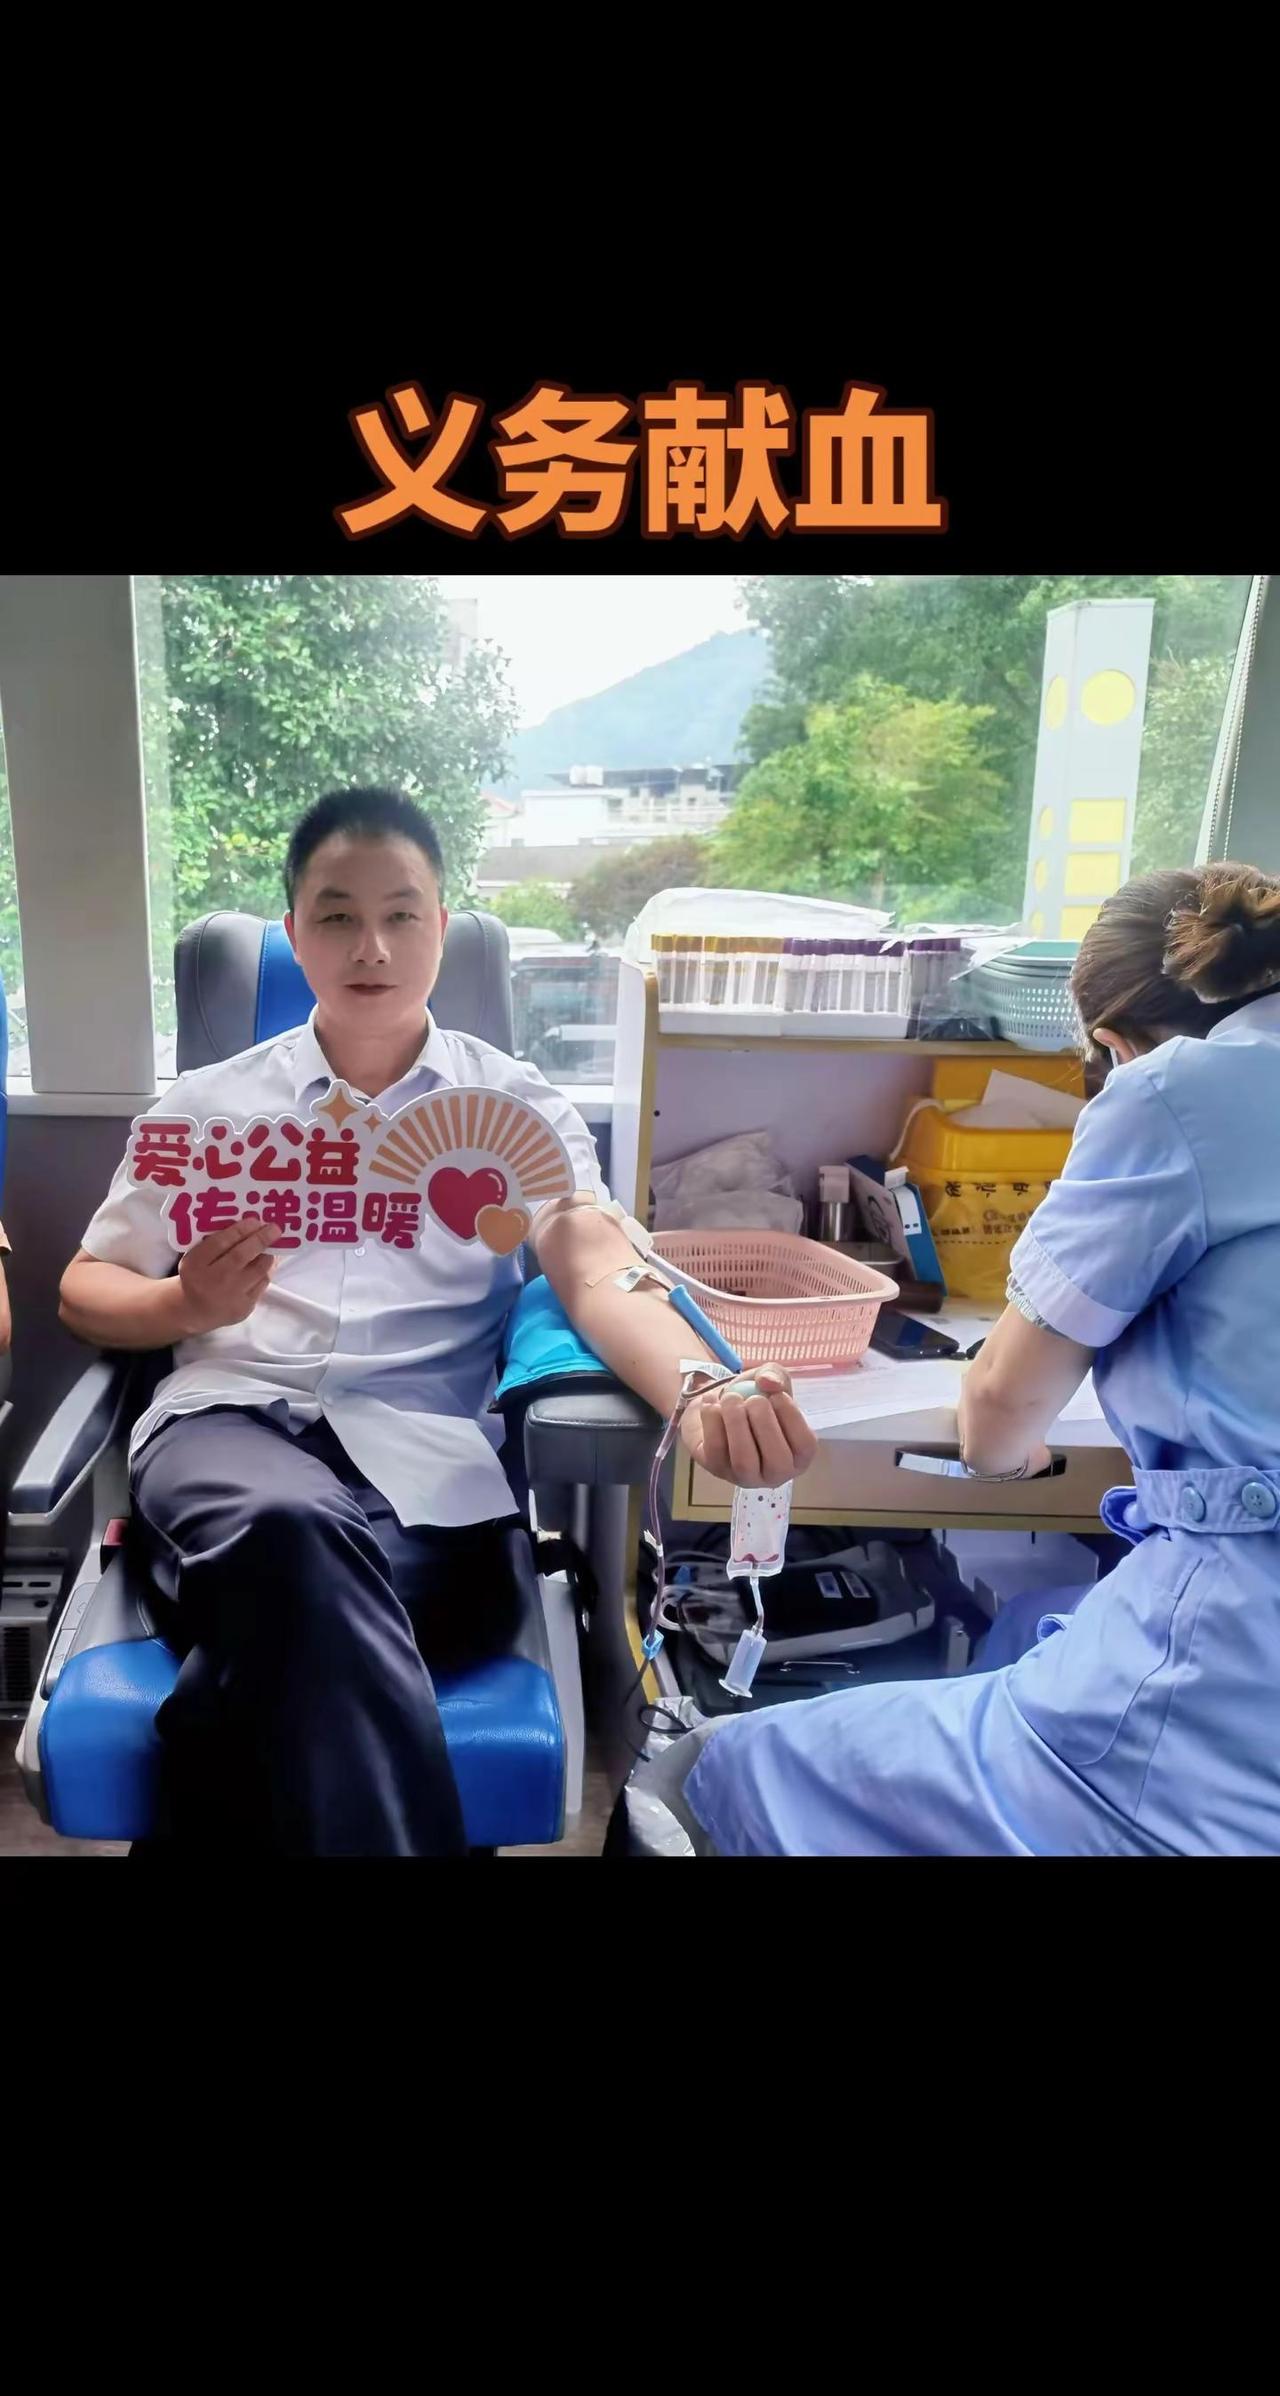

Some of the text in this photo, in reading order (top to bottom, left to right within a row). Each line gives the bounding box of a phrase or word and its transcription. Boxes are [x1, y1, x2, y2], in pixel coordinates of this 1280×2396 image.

[133, 1122, 361, 1187] 爱心公益
[168, 1186, 422, 1250] 传递温暖
